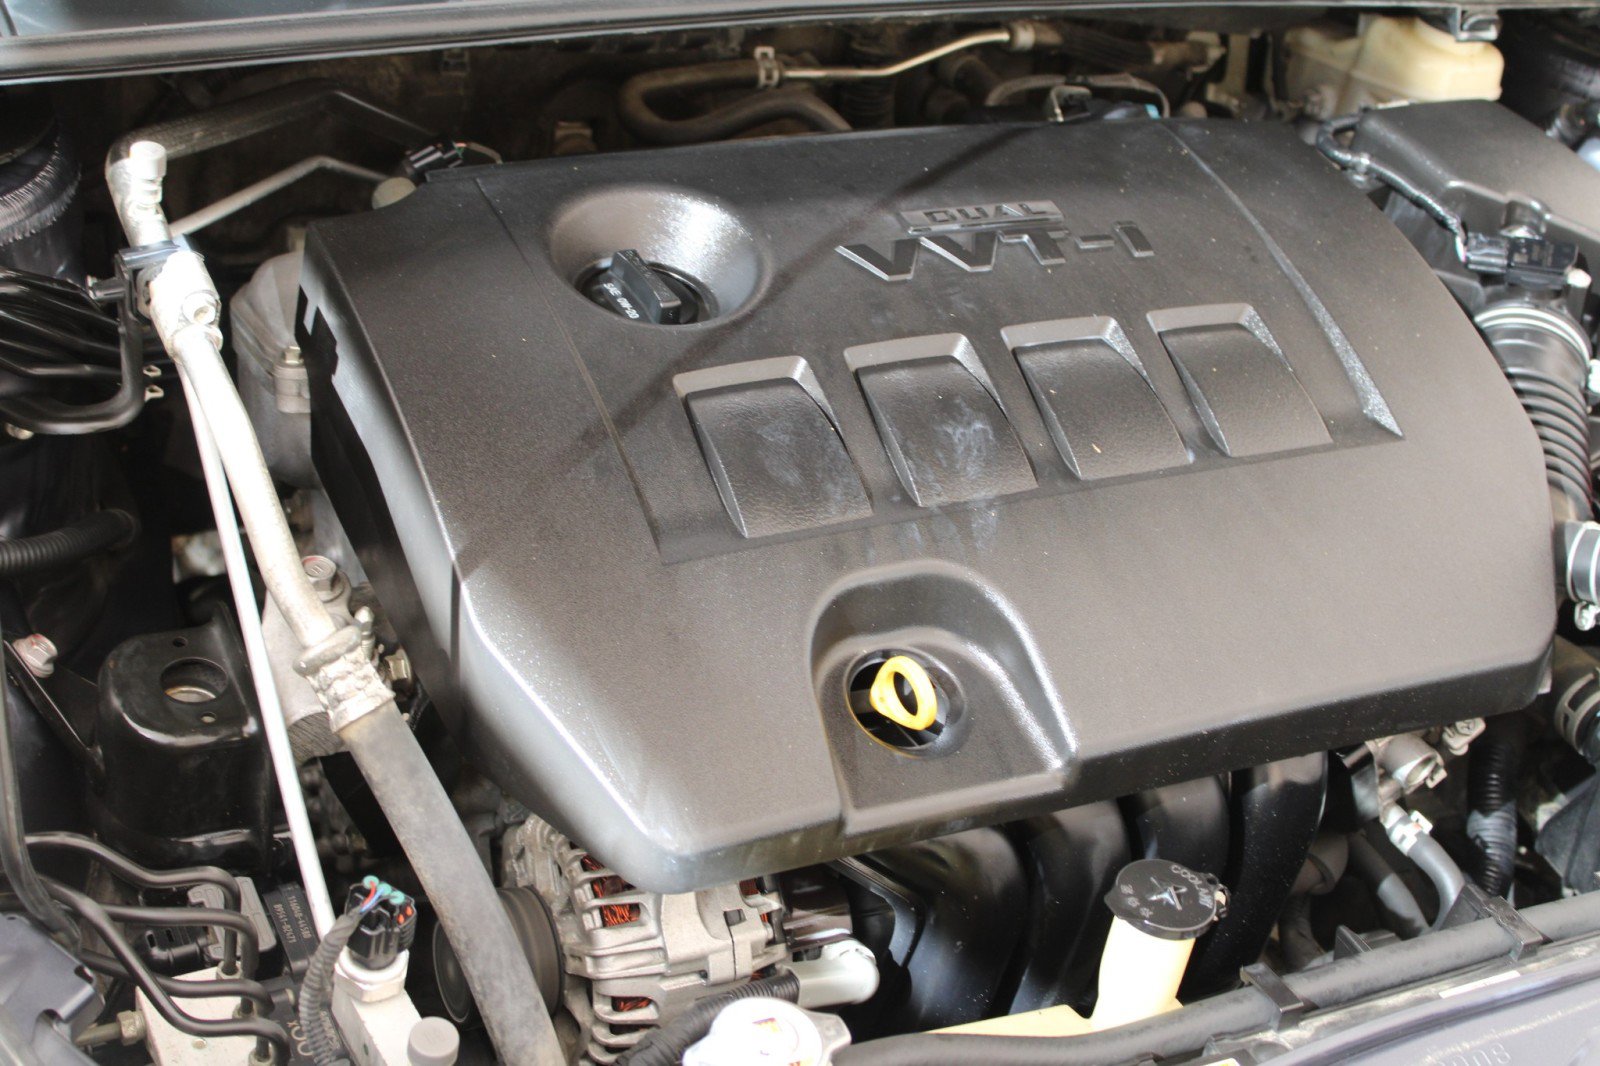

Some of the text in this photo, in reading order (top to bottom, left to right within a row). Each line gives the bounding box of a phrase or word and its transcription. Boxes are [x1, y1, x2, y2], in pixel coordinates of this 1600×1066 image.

[922, 202, 1048, 223] DUAL
[602, 282, 640, 319] SAE 0W-20
[1171, 864, 1214, 909] COOLANT
